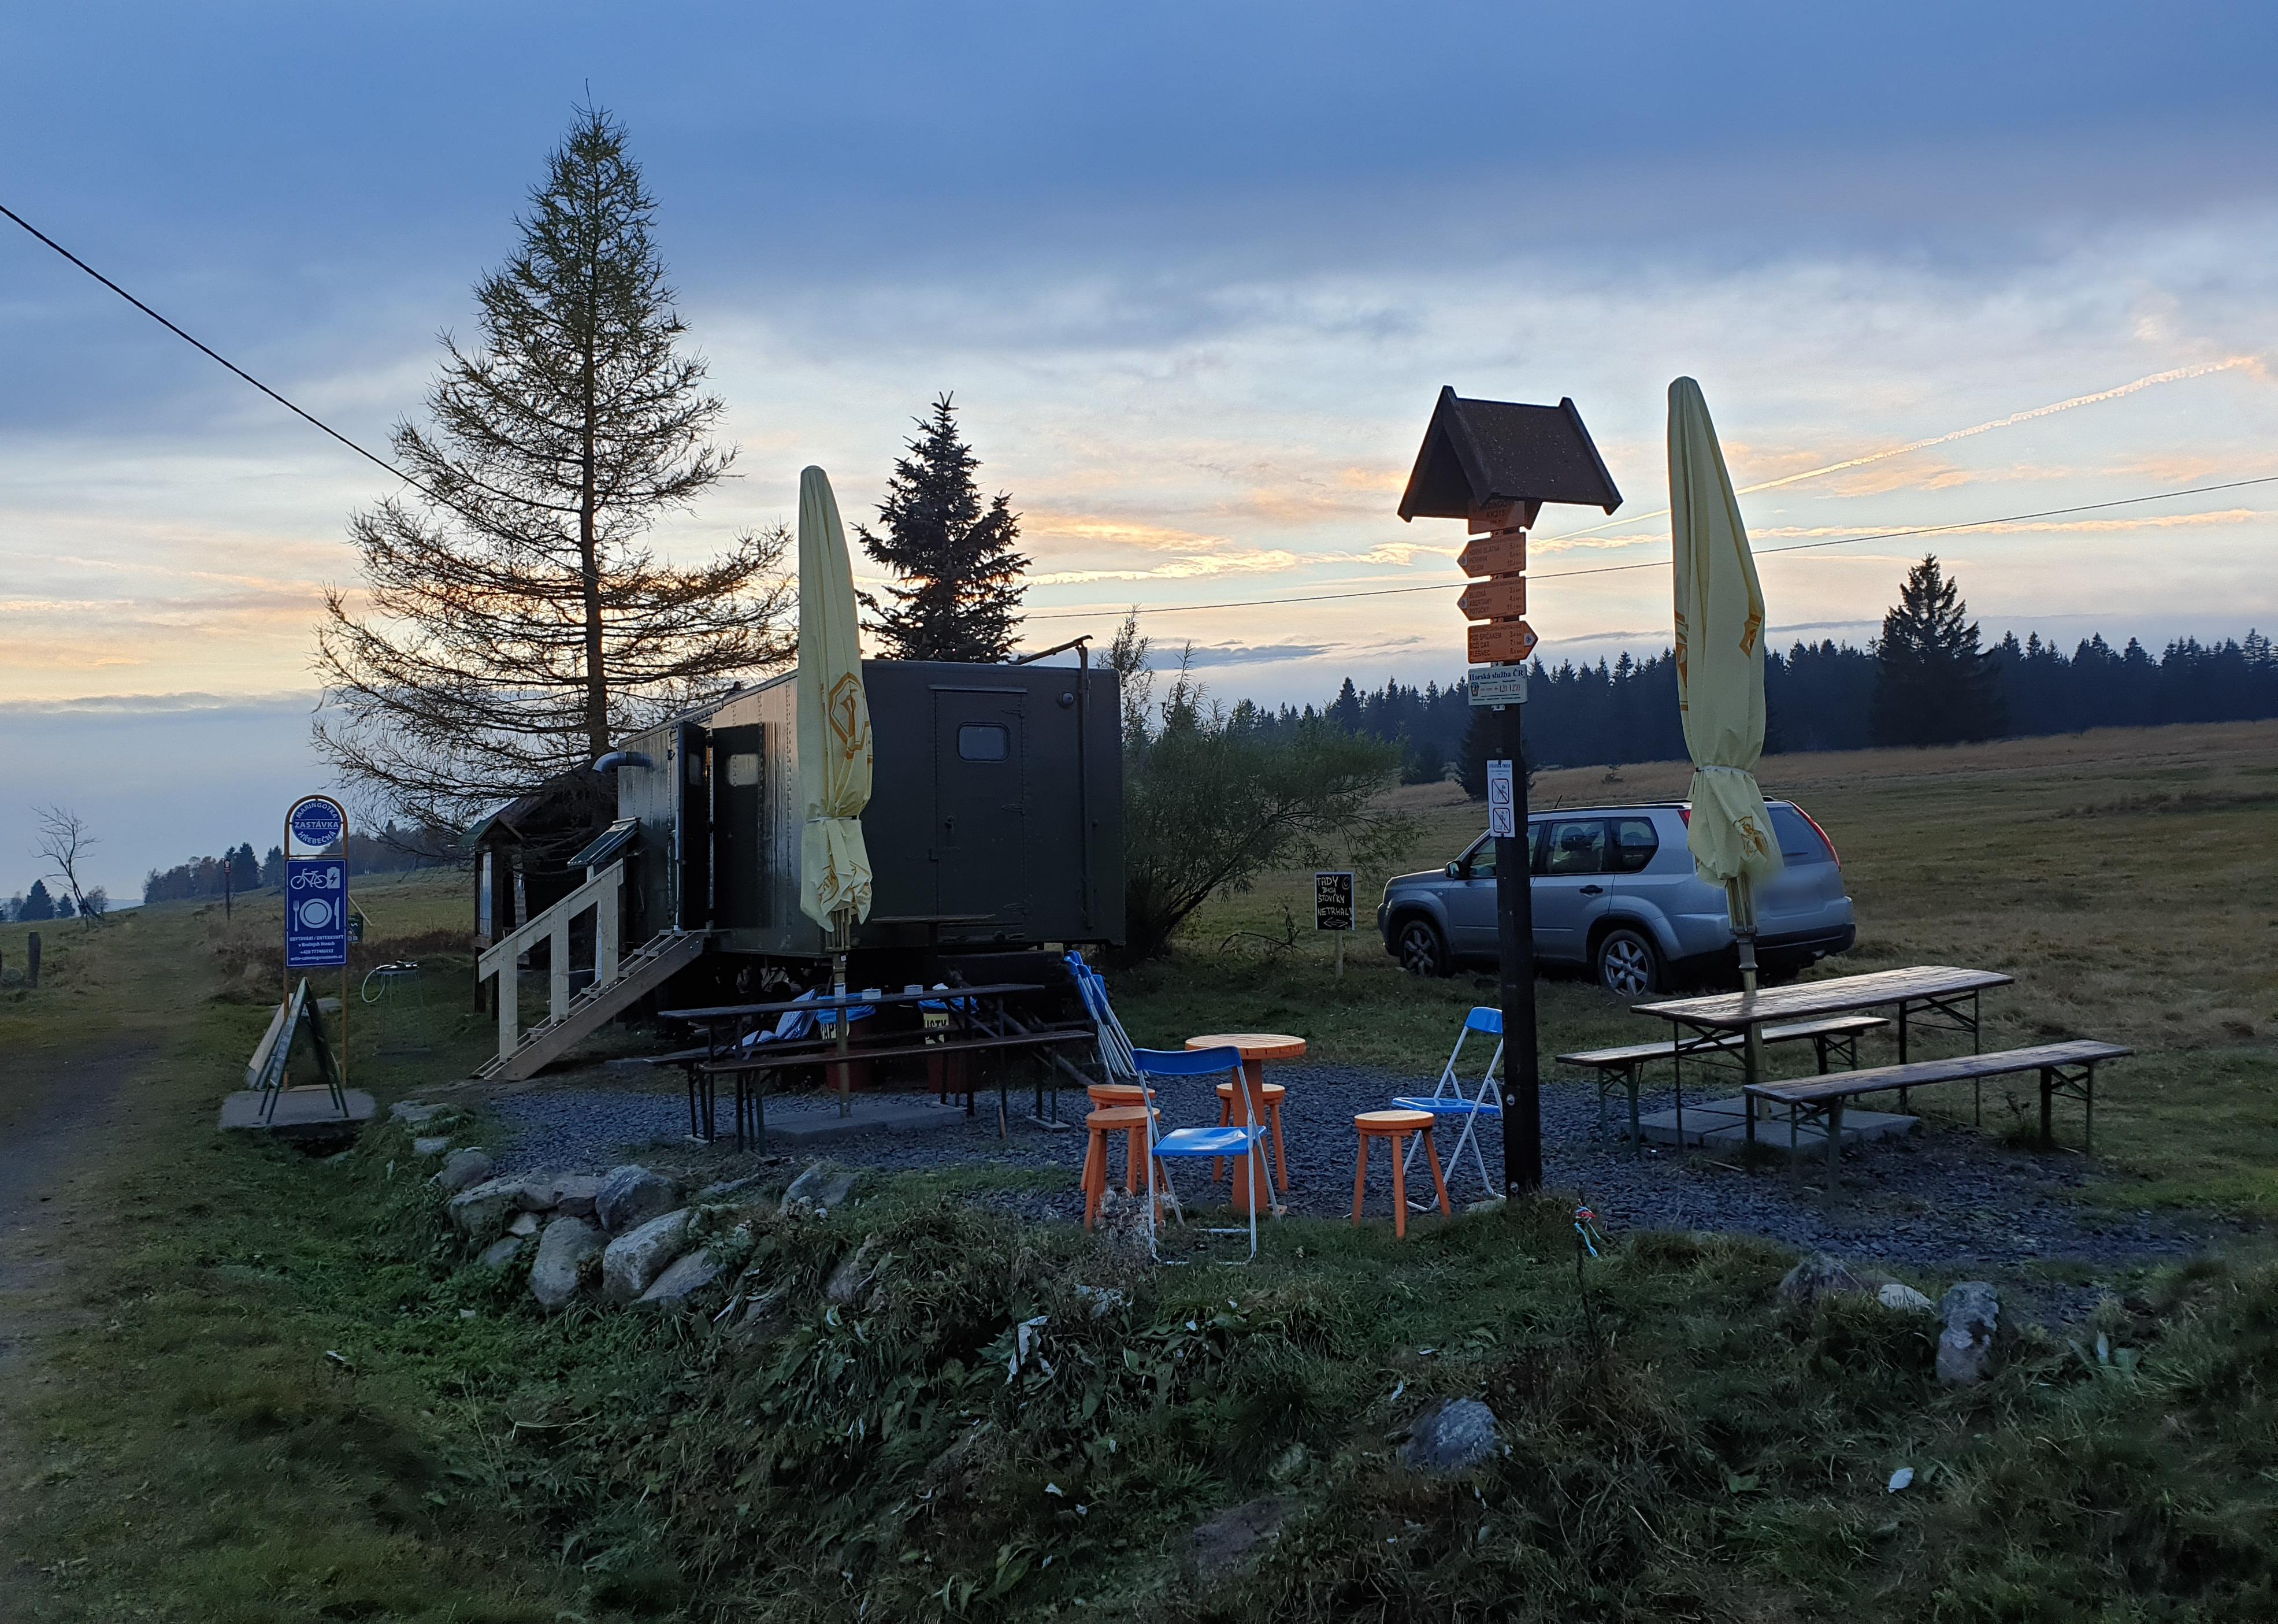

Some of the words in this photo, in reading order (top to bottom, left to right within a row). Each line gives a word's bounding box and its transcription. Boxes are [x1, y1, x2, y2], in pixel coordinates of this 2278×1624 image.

[1470, 673, 1490, 681] Horská
[1513, 669, 1523, 677] ČR
[296, 802, 337, 818] MARINGOTKA
[298, 830, 336, 844] HŘEBEČNÁ
[1316, 876, 1338, 887] TADY
